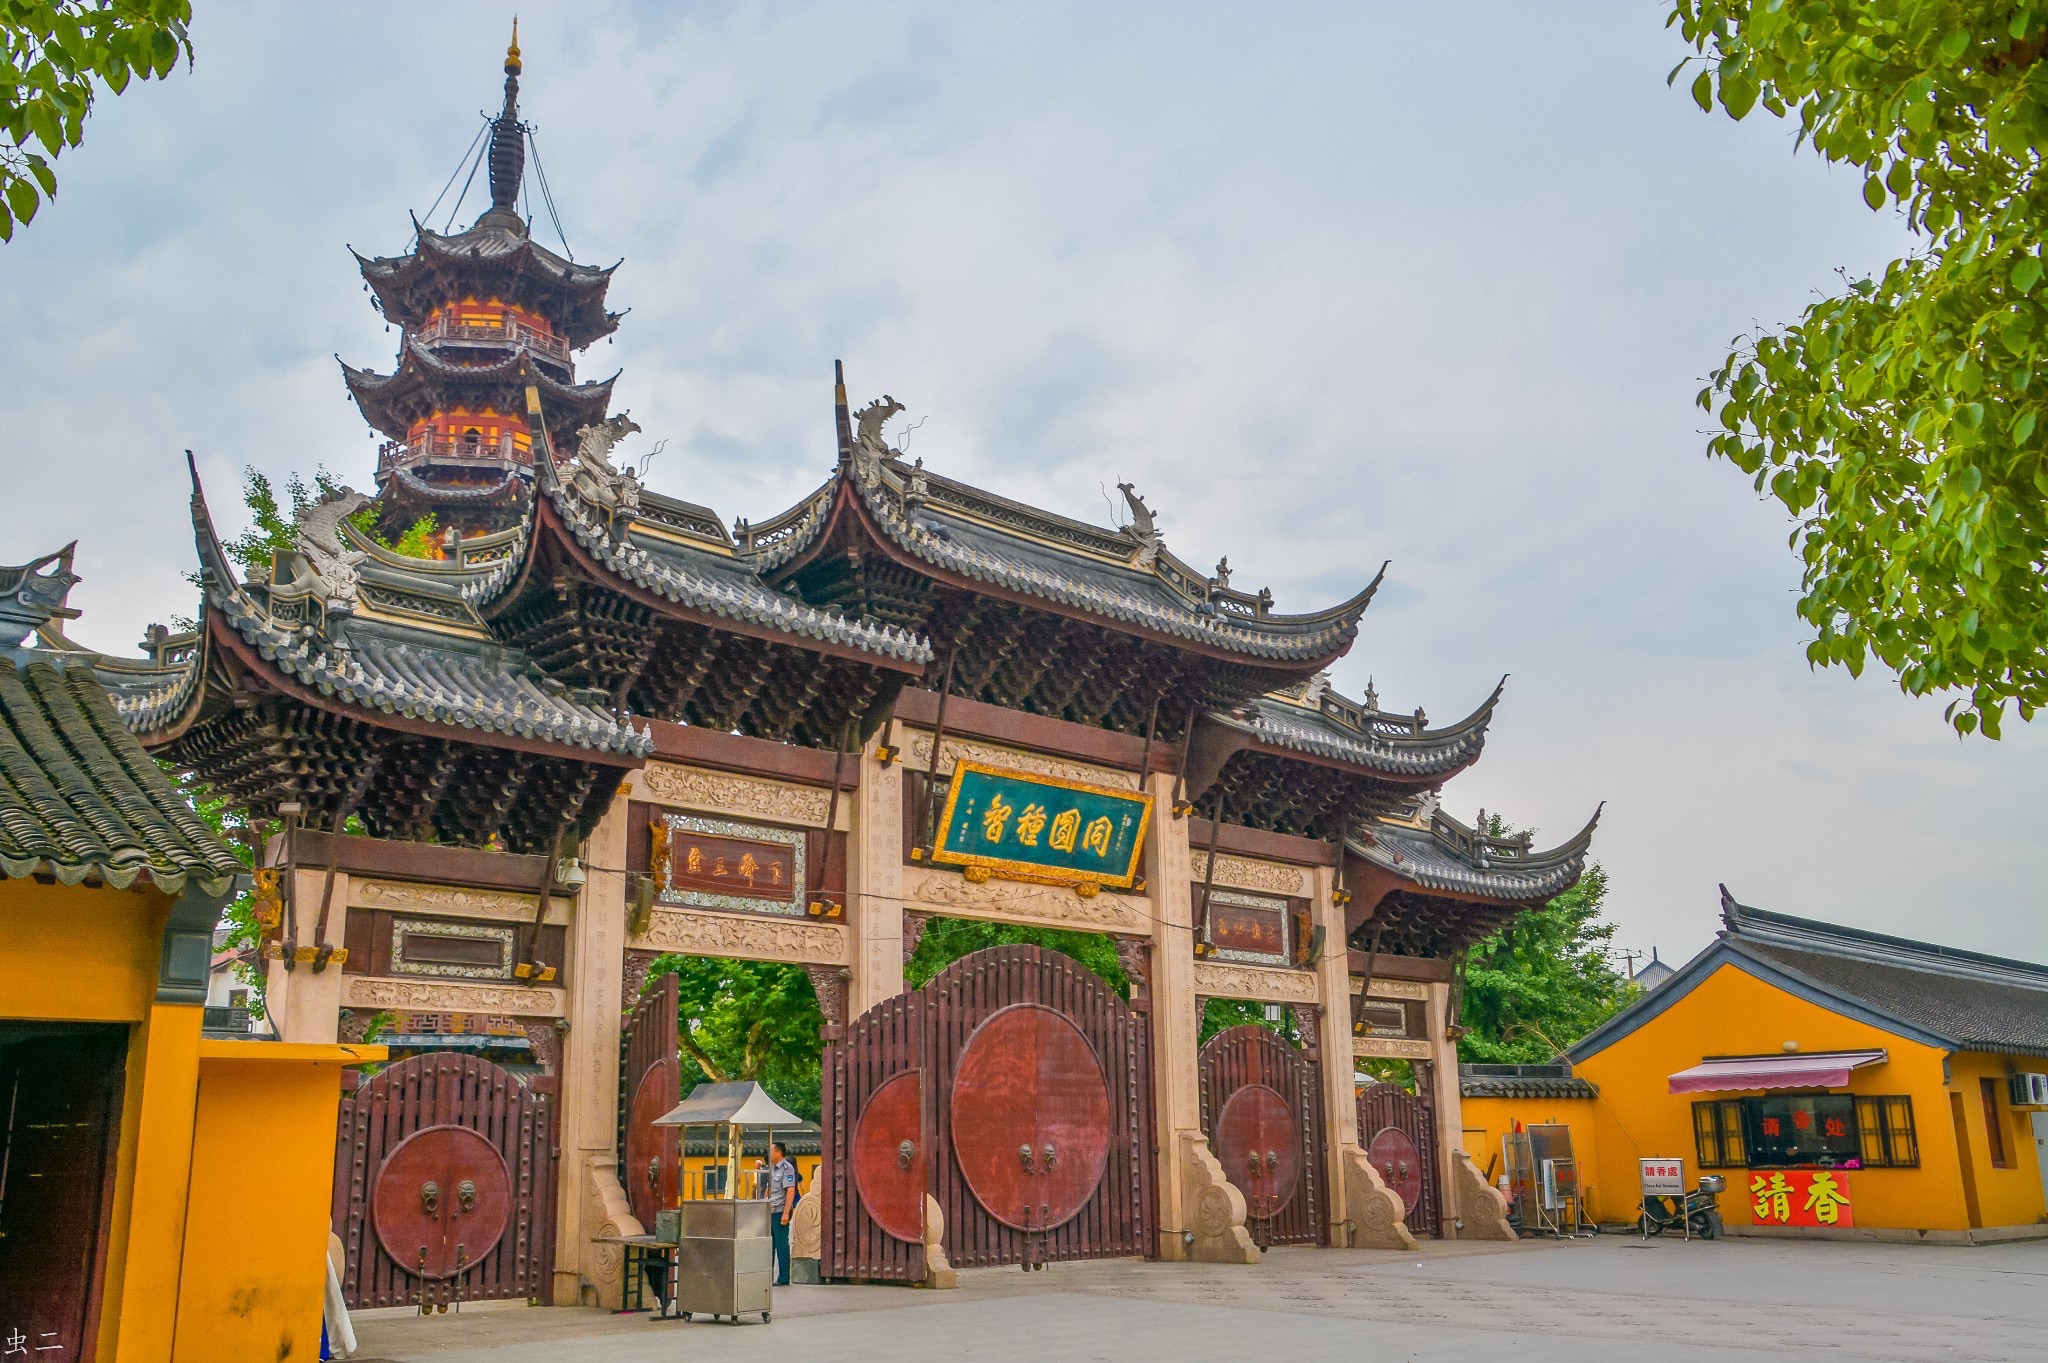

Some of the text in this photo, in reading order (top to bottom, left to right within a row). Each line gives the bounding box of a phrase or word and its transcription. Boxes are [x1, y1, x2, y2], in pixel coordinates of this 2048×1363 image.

[1645, 1166, 1678, 1177] 請香處
[1750, 1172, 1850, 1224] 請香
